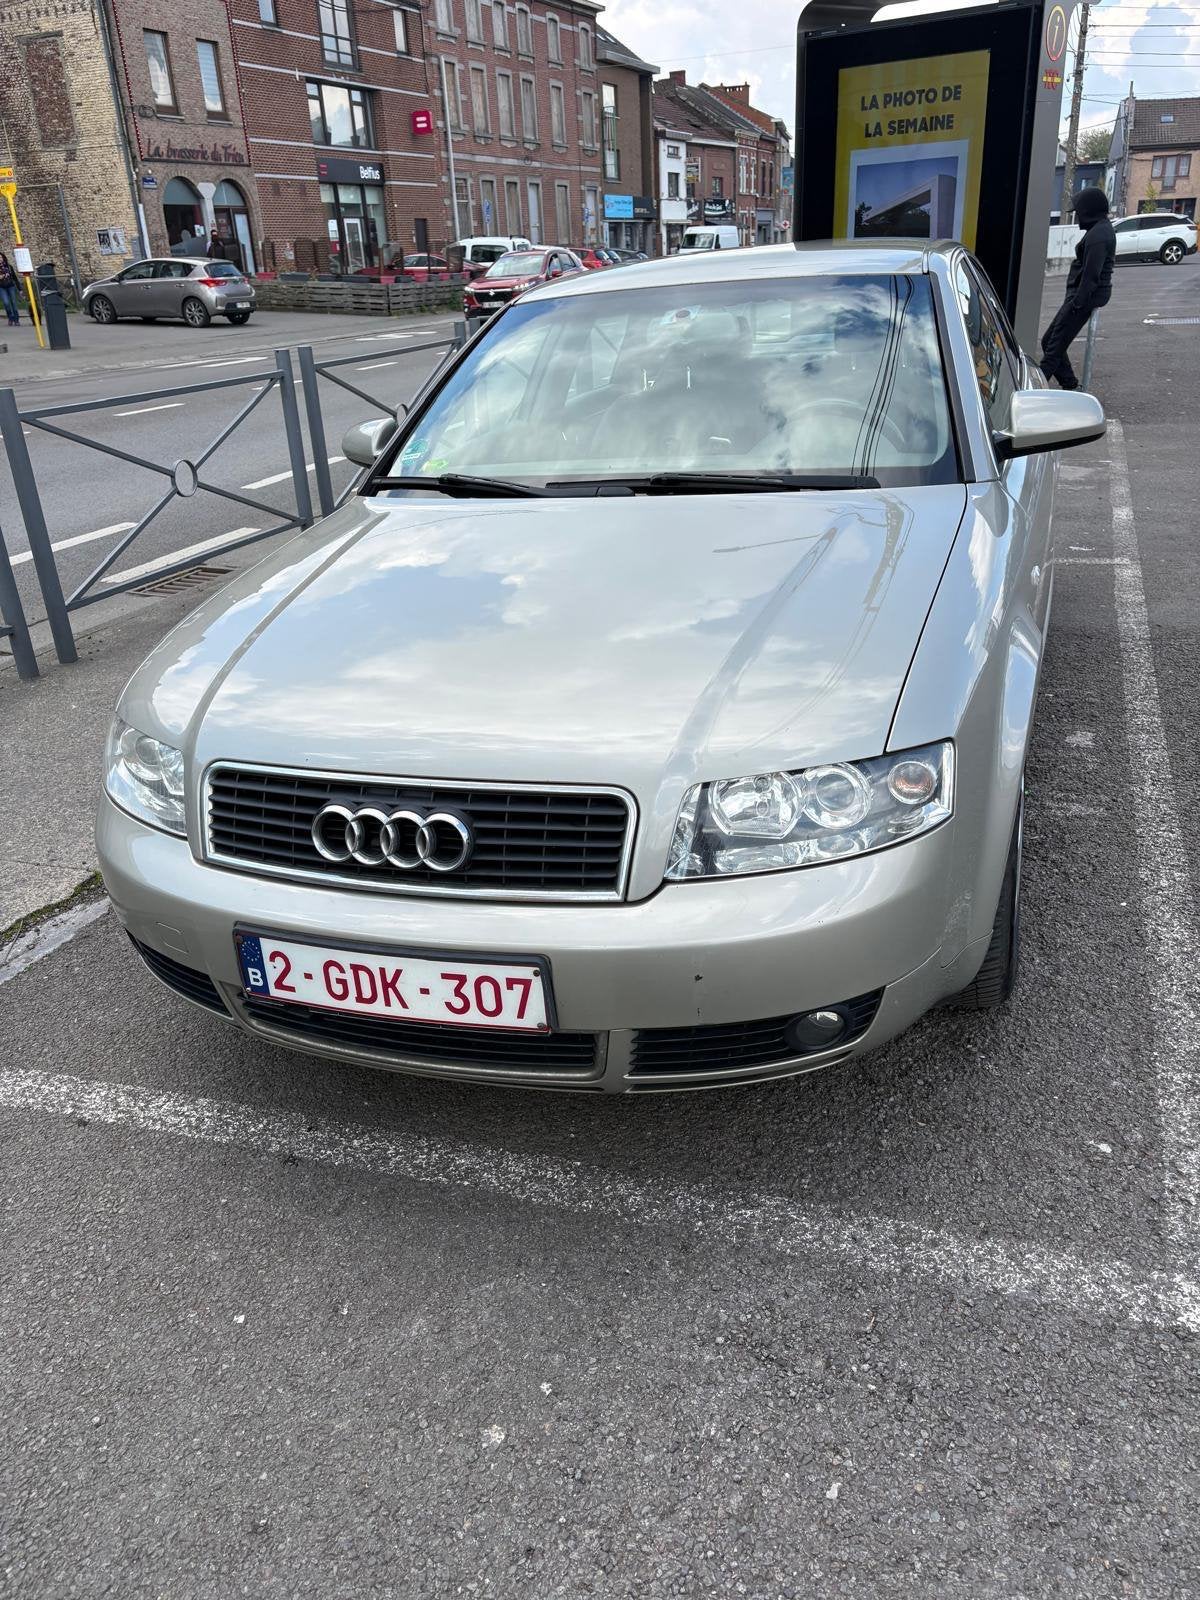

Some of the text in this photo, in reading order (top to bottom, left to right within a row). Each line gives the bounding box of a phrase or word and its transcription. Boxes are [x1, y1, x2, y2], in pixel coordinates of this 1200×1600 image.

[861, 84, 962, 111] LA PHOTO DE
[864, 114, 955, 138] LA SEMAINE
[166, 138, 209, 160] brasserie
[360, 165, 380, 180] Belfius
[247, 967, 264, 987] B
